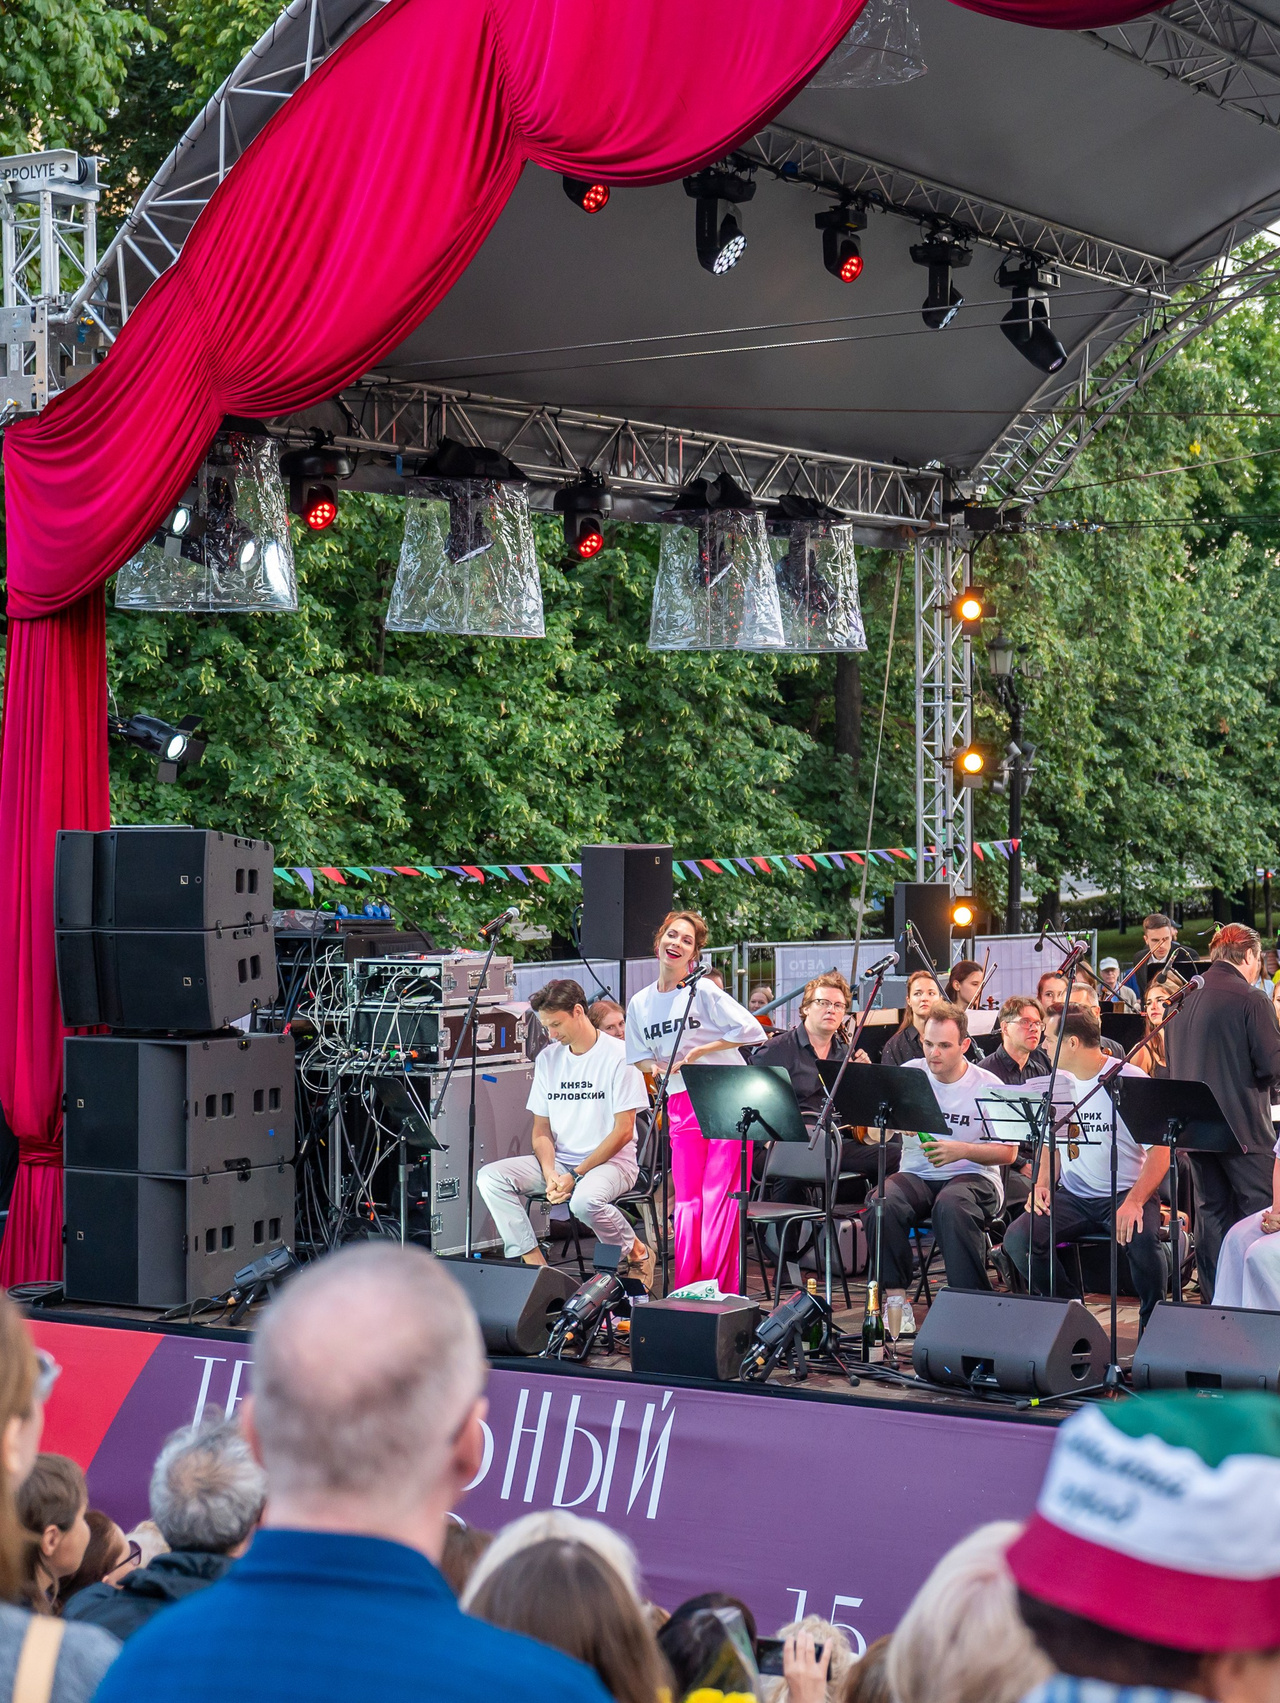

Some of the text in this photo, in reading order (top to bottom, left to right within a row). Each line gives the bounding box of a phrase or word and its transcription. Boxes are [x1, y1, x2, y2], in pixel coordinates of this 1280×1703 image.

[4, 162, 55, 180] PPOLYTE
[643, 1016, 702, 1040] АДЕЛЬ
[560, 1080, 593, 1090] КНЯЗЬ
[547, 1090, 606, 1101] ОРЛОВСКИЙ
[1081, 1112, 1102, 1121] РИХ
